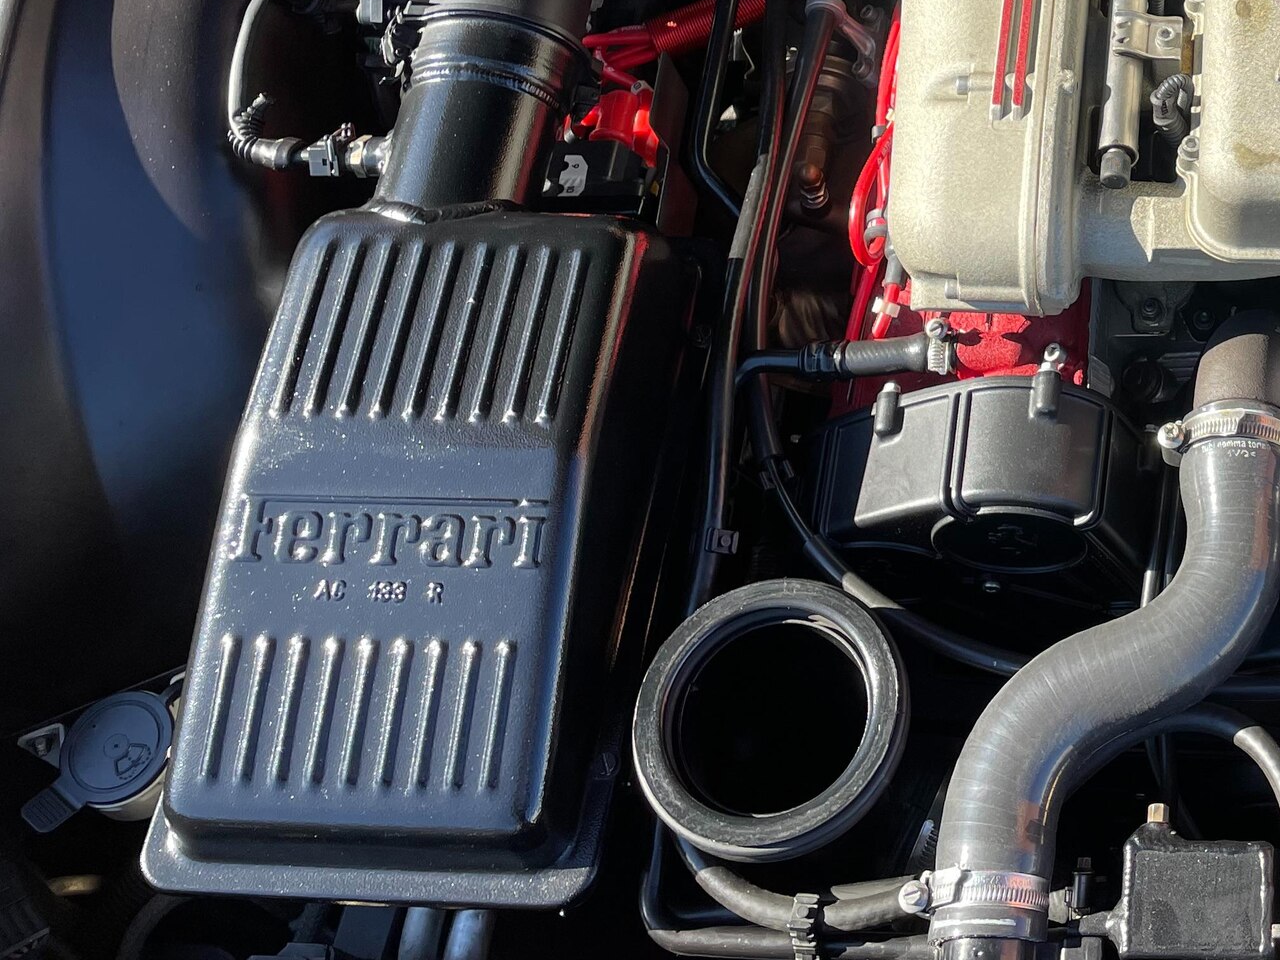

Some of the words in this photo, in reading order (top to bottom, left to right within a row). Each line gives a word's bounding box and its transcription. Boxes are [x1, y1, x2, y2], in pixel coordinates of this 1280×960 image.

[230, 494, 549, 568] Ferrari
[313, 579, 347, 601] AC
[426, 582, 445, 603] R
